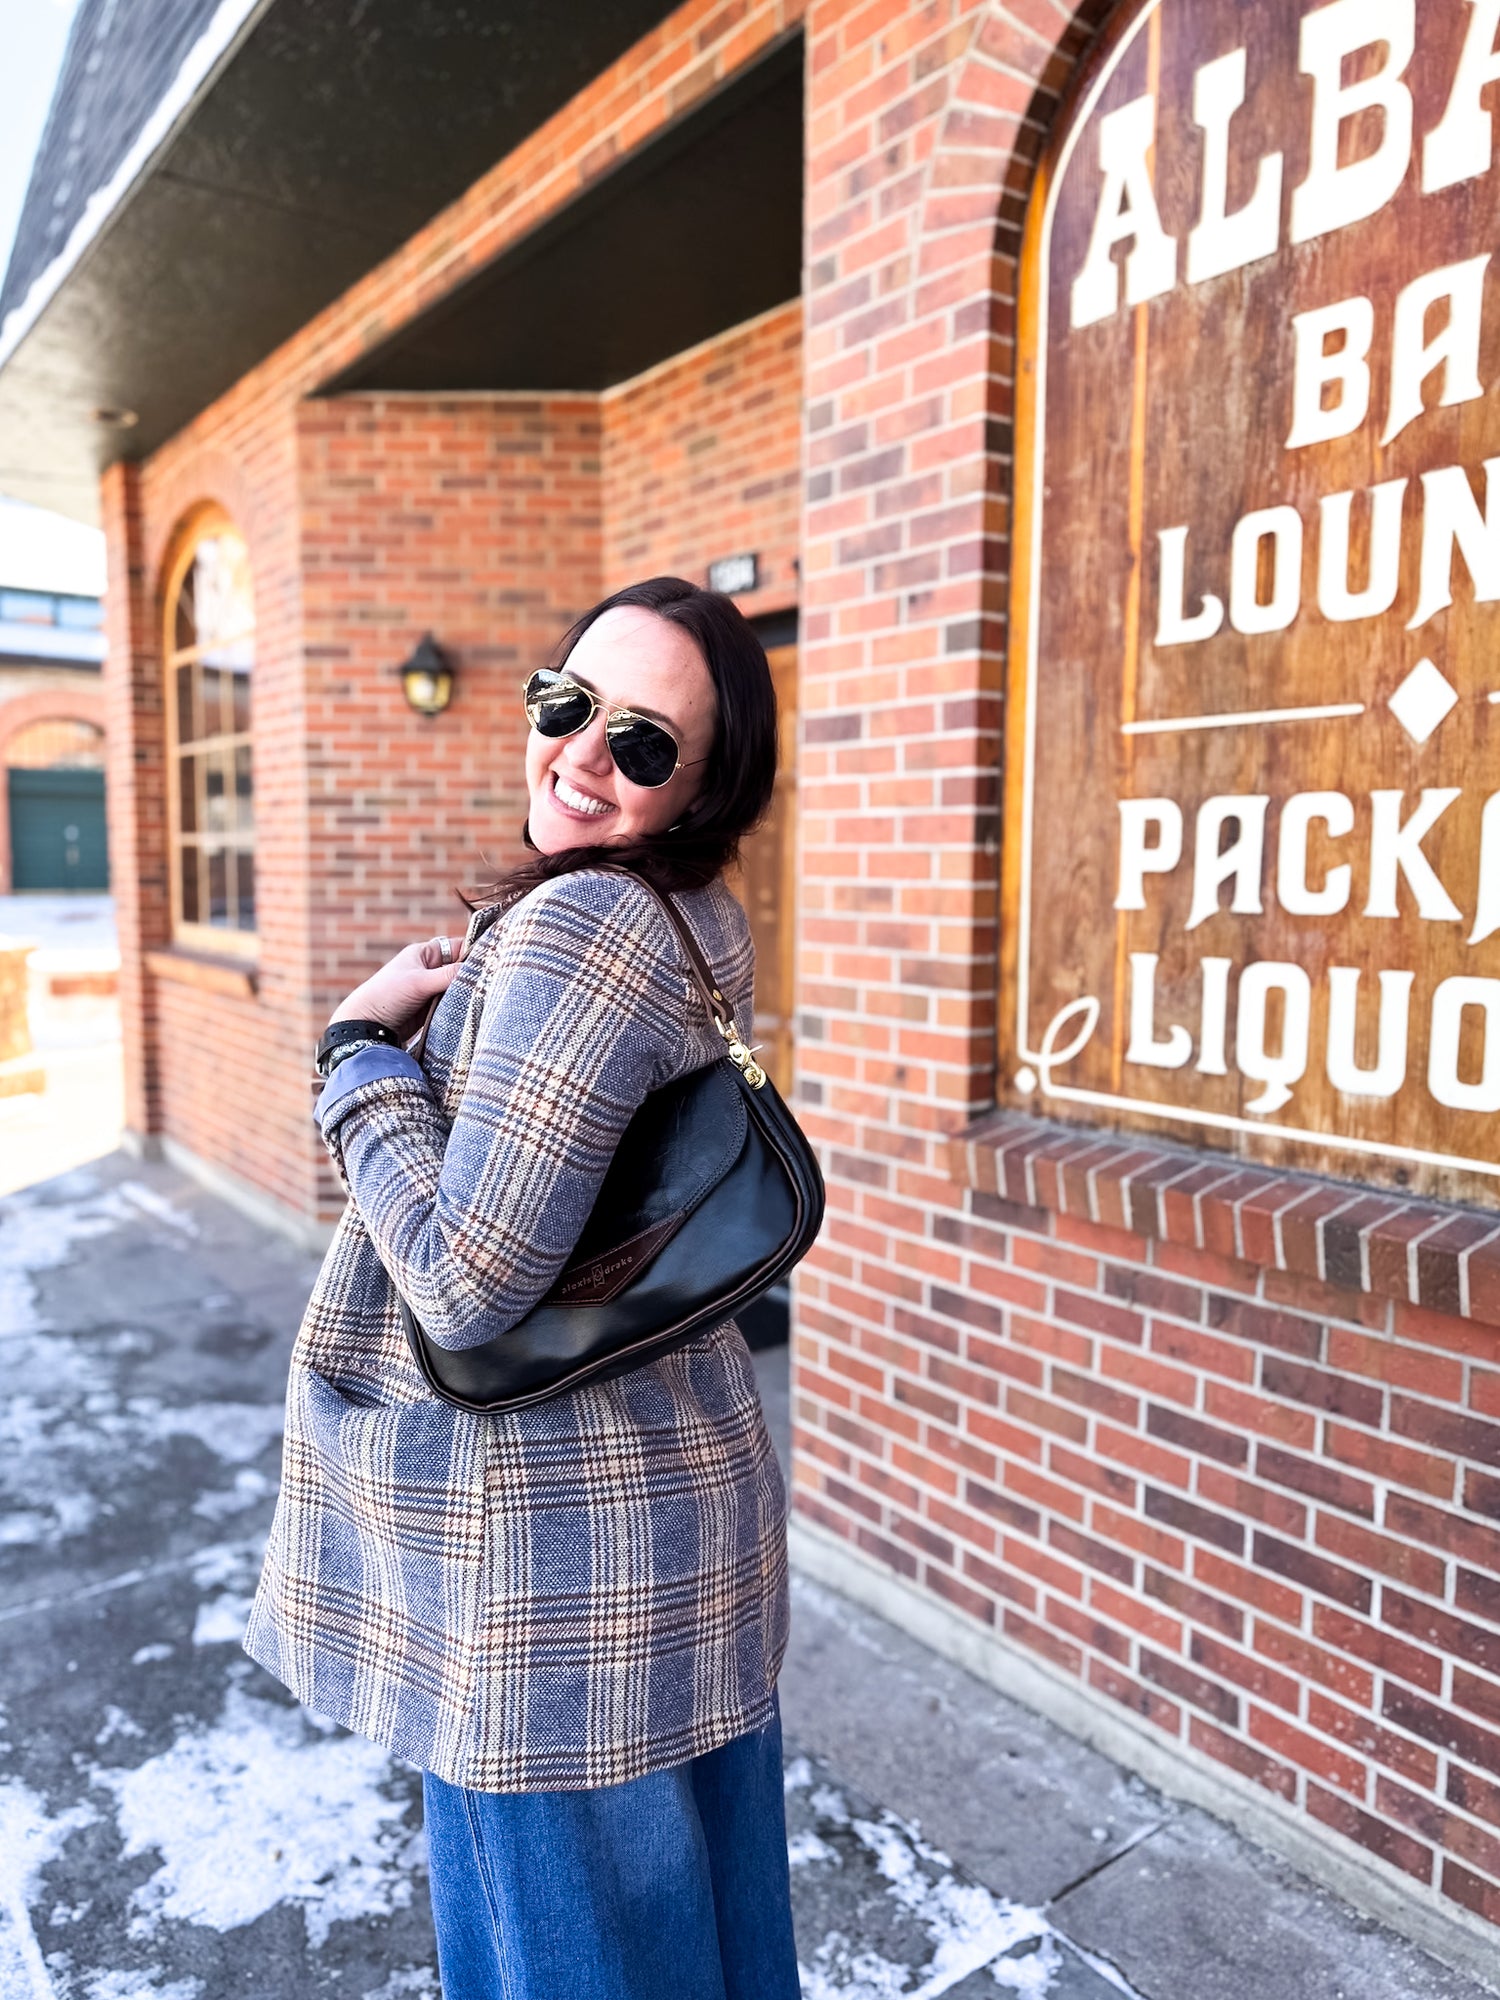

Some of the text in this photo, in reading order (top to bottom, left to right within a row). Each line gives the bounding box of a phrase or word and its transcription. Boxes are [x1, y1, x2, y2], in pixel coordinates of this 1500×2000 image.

[1154, 457, 1500, 646] LOUN
[1126, 952, 1500, 1115] LIQUO
[561, 1256, 633, 1294] alexis drake
